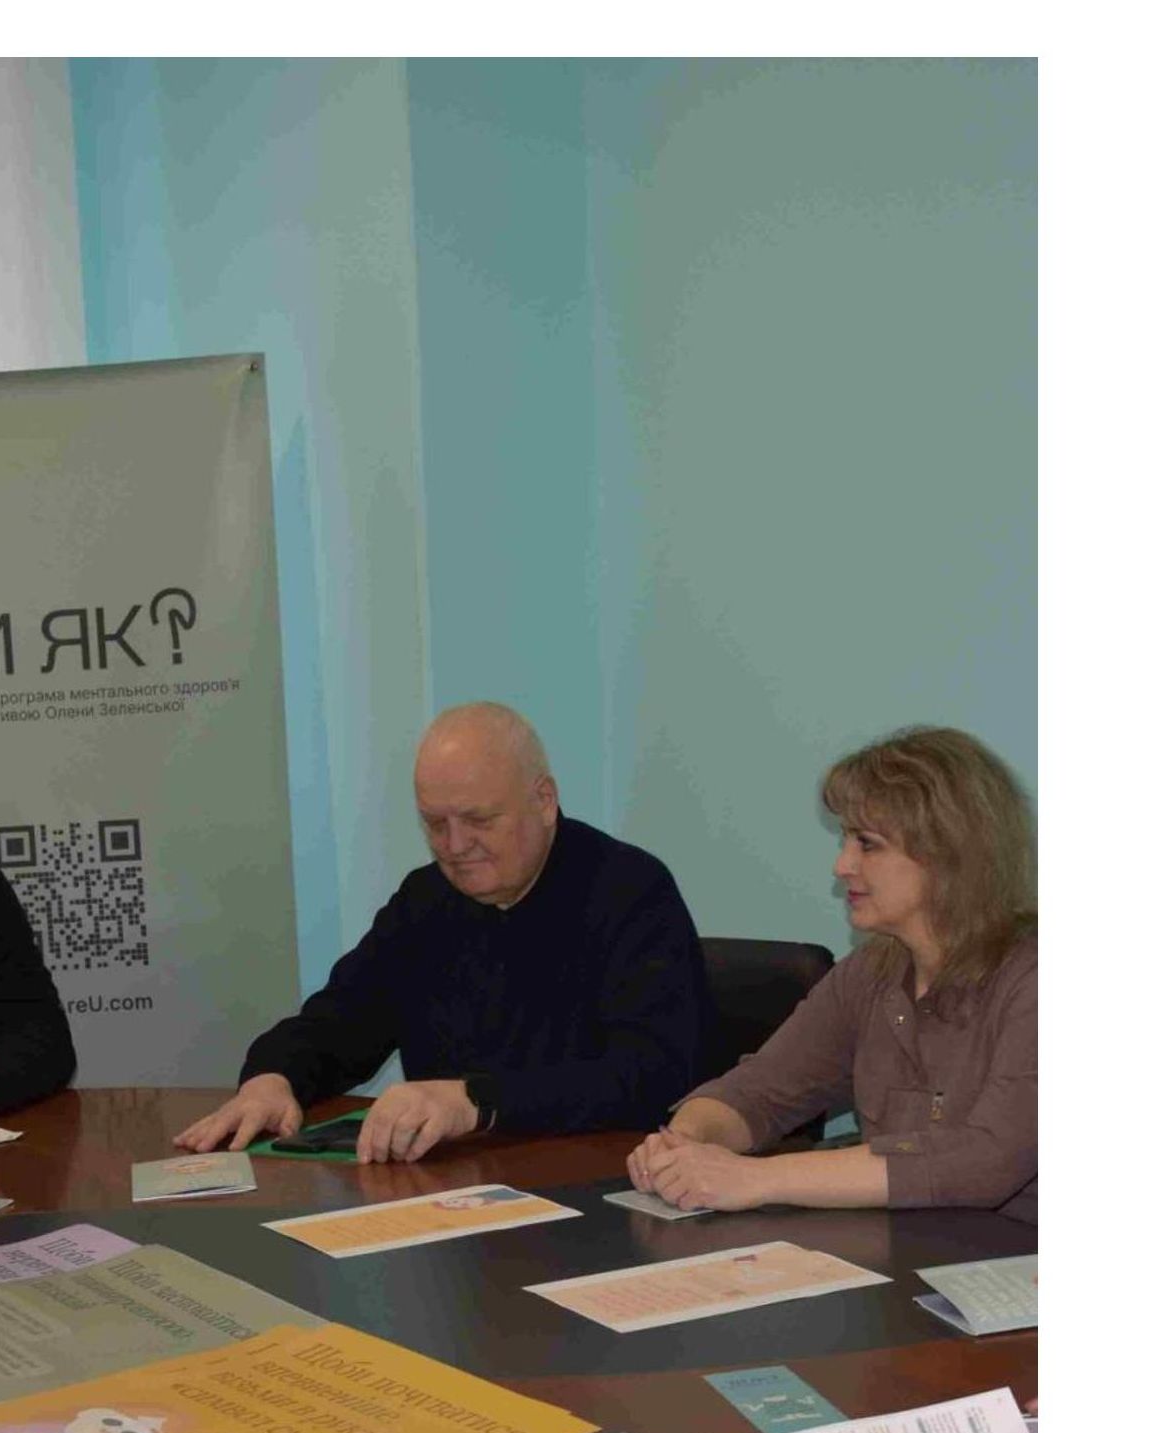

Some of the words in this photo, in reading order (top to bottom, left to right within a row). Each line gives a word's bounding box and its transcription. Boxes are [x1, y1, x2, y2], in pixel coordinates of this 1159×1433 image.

[40, 587, 197, 674] ЯК?
[69, 683, 170, 703] ментального
[45, 705, 95, 721] Олени
[99, 699, 186, 718] Зеленської
[63, 995, 153, 1014] reU.com
[292, 1343, 377, 1385] Щоби
